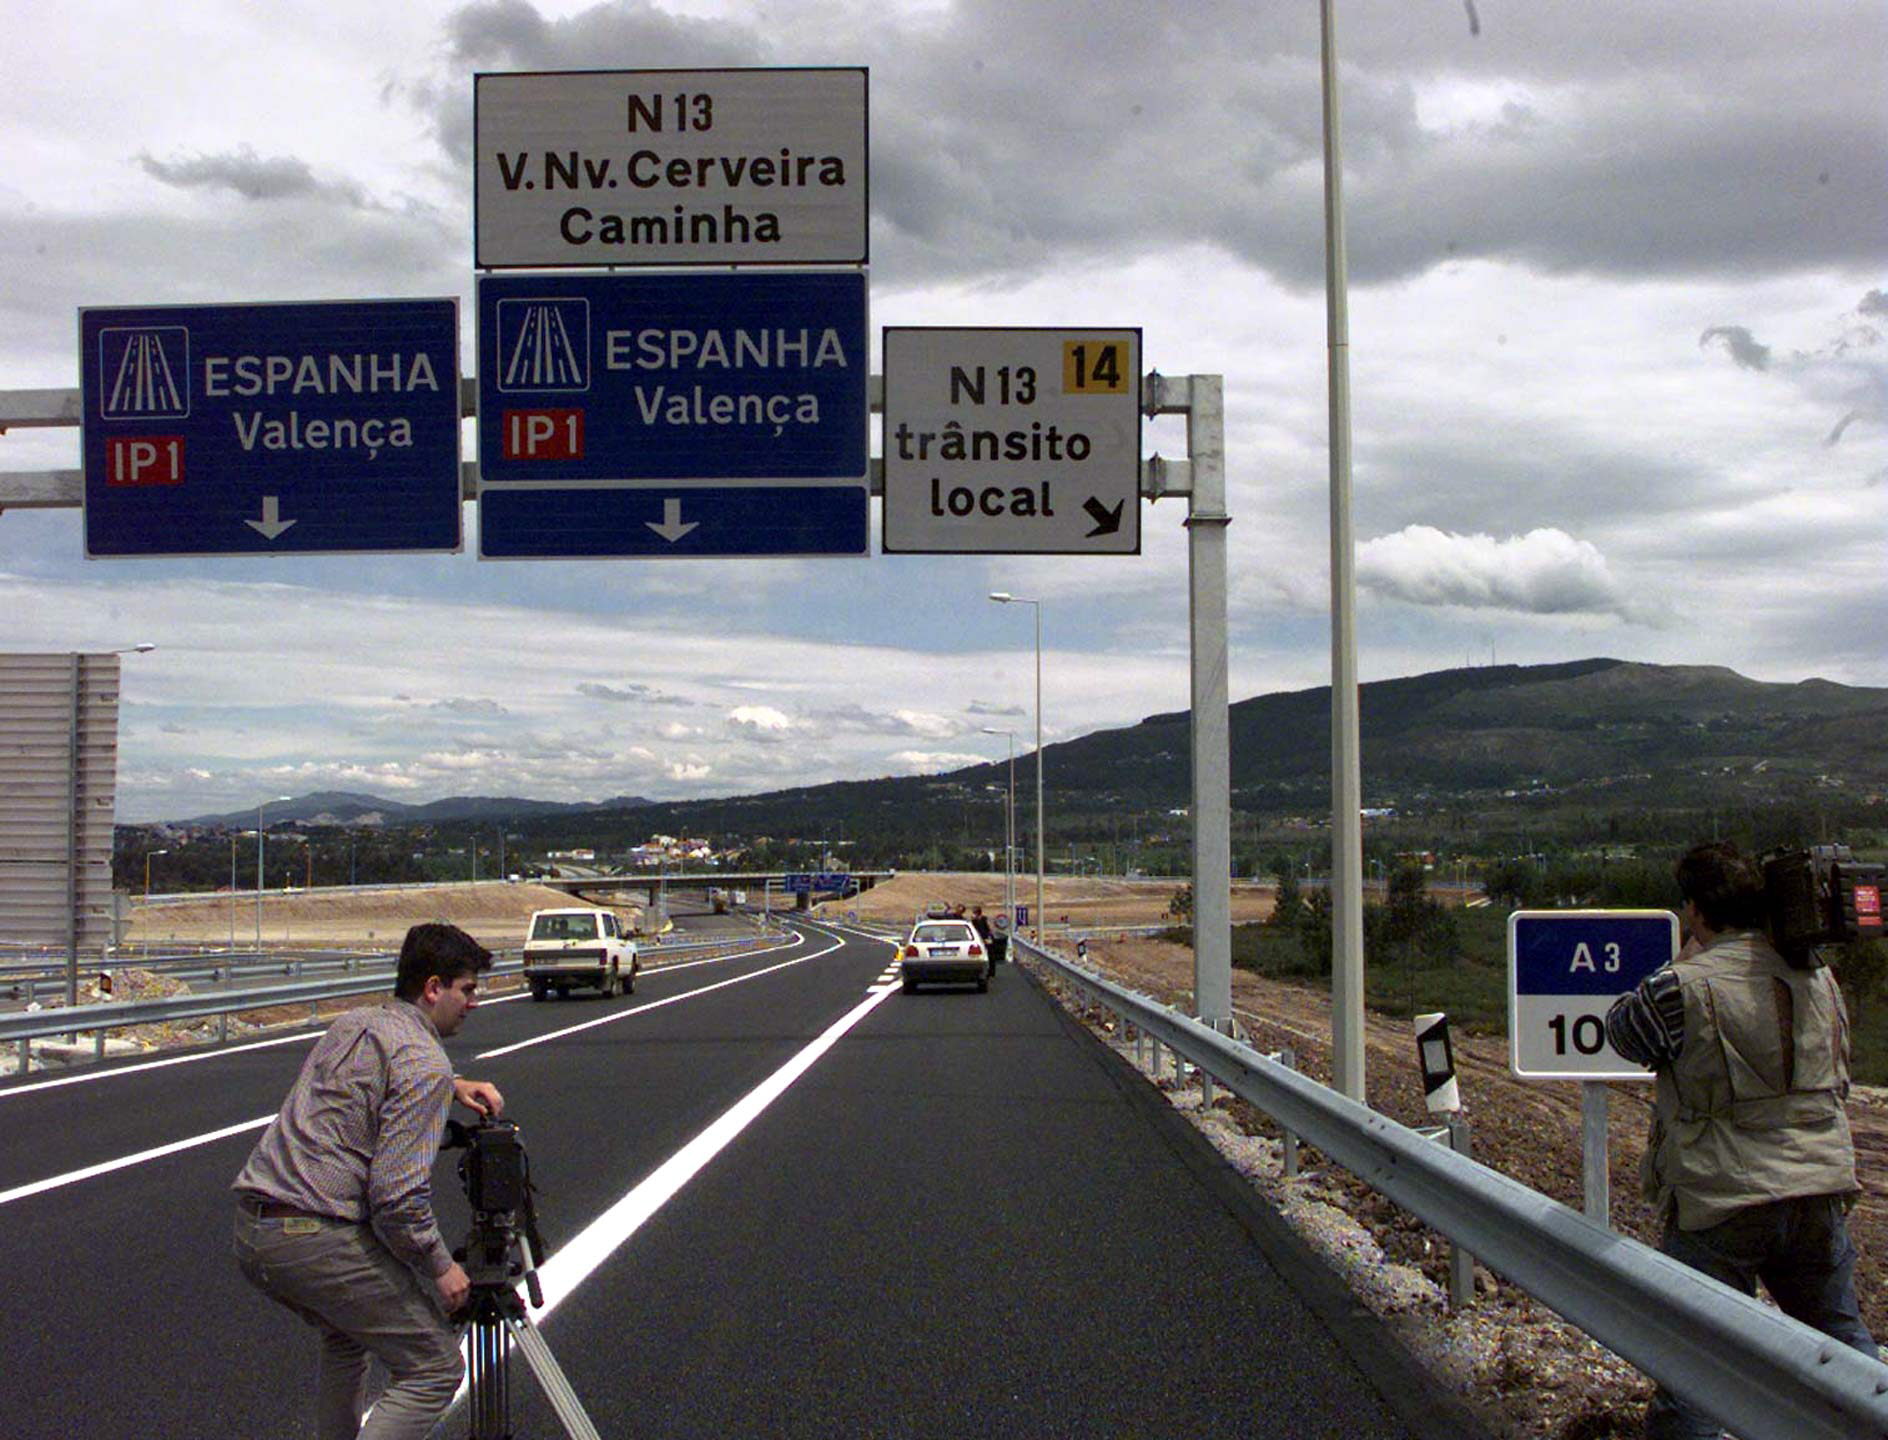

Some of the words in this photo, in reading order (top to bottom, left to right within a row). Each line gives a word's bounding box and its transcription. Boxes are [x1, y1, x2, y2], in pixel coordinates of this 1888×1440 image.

[560, 204, 782, 246] Caminha
[606, 328, 848, 370] ESPANHA
[1071, 345, 1121, 389] 14
[205, 352, 439, 397] ESPANHA
[634, 385, 820, 438] Valença
[232, 410, 414, 461] Valença
[894, 420, 1091, 461] trânsito
[931, 477, 1055, 518] local
[1548, 1014, 1606, 1056] 10
